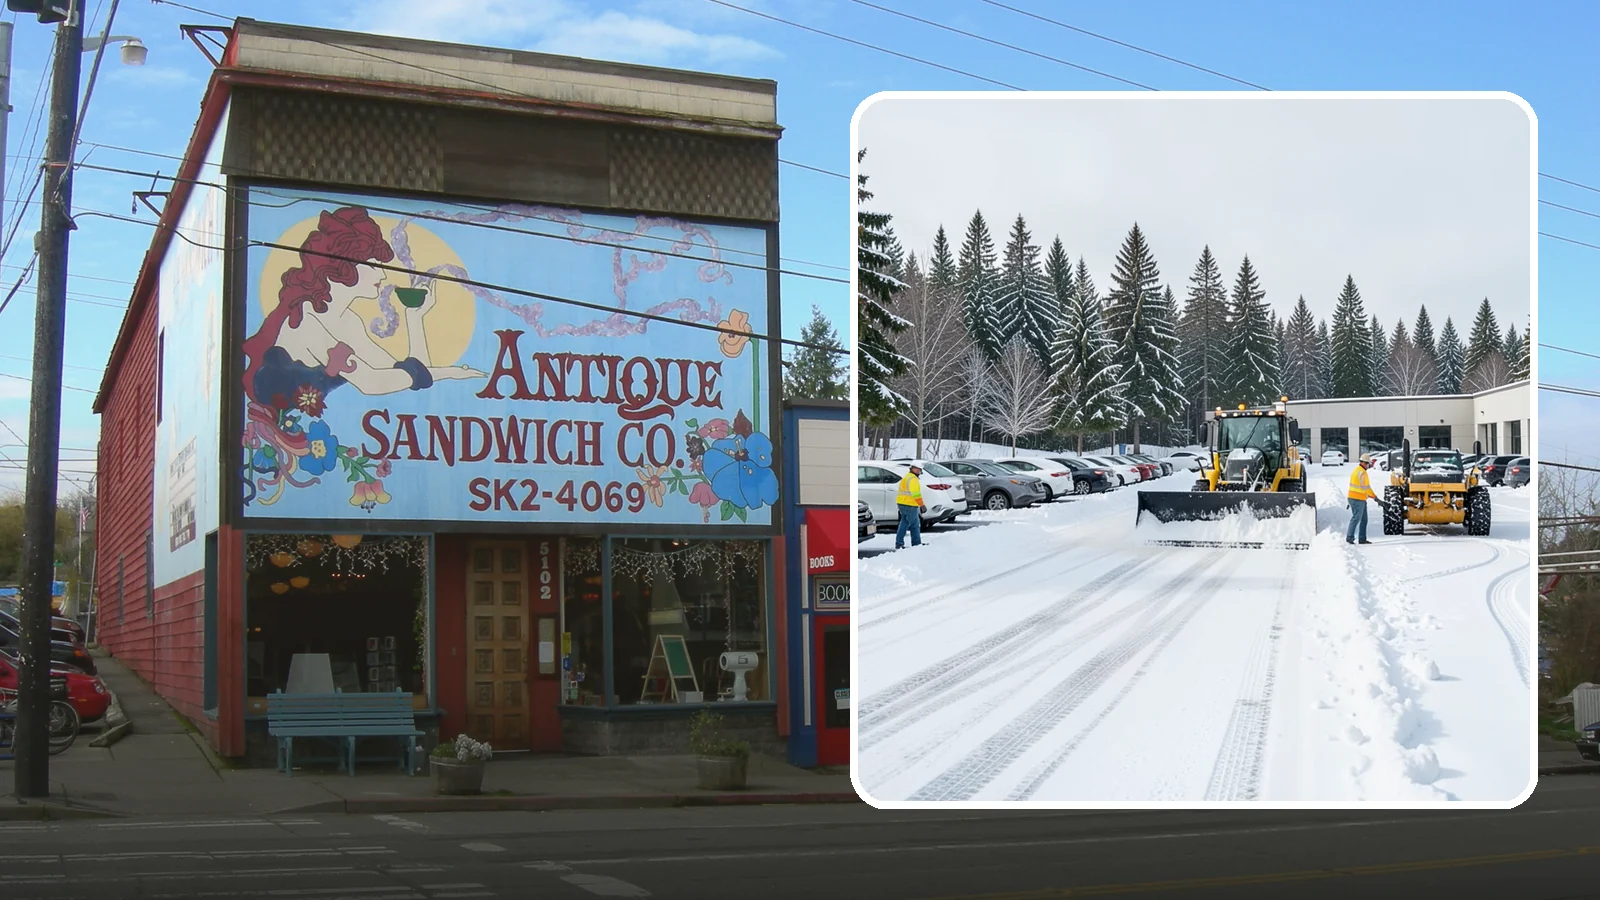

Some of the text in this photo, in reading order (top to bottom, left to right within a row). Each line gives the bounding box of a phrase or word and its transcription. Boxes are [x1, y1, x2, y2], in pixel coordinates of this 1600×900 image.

[476, 328, 723, 420] ANTIQUE
[362, 407, 685, 468] SANDWICH CO.
[468, 477, 646, 512] SK2-4069
[539, 542, 552, 600] 5102
[809, 555, 834, 569] BOOKS
